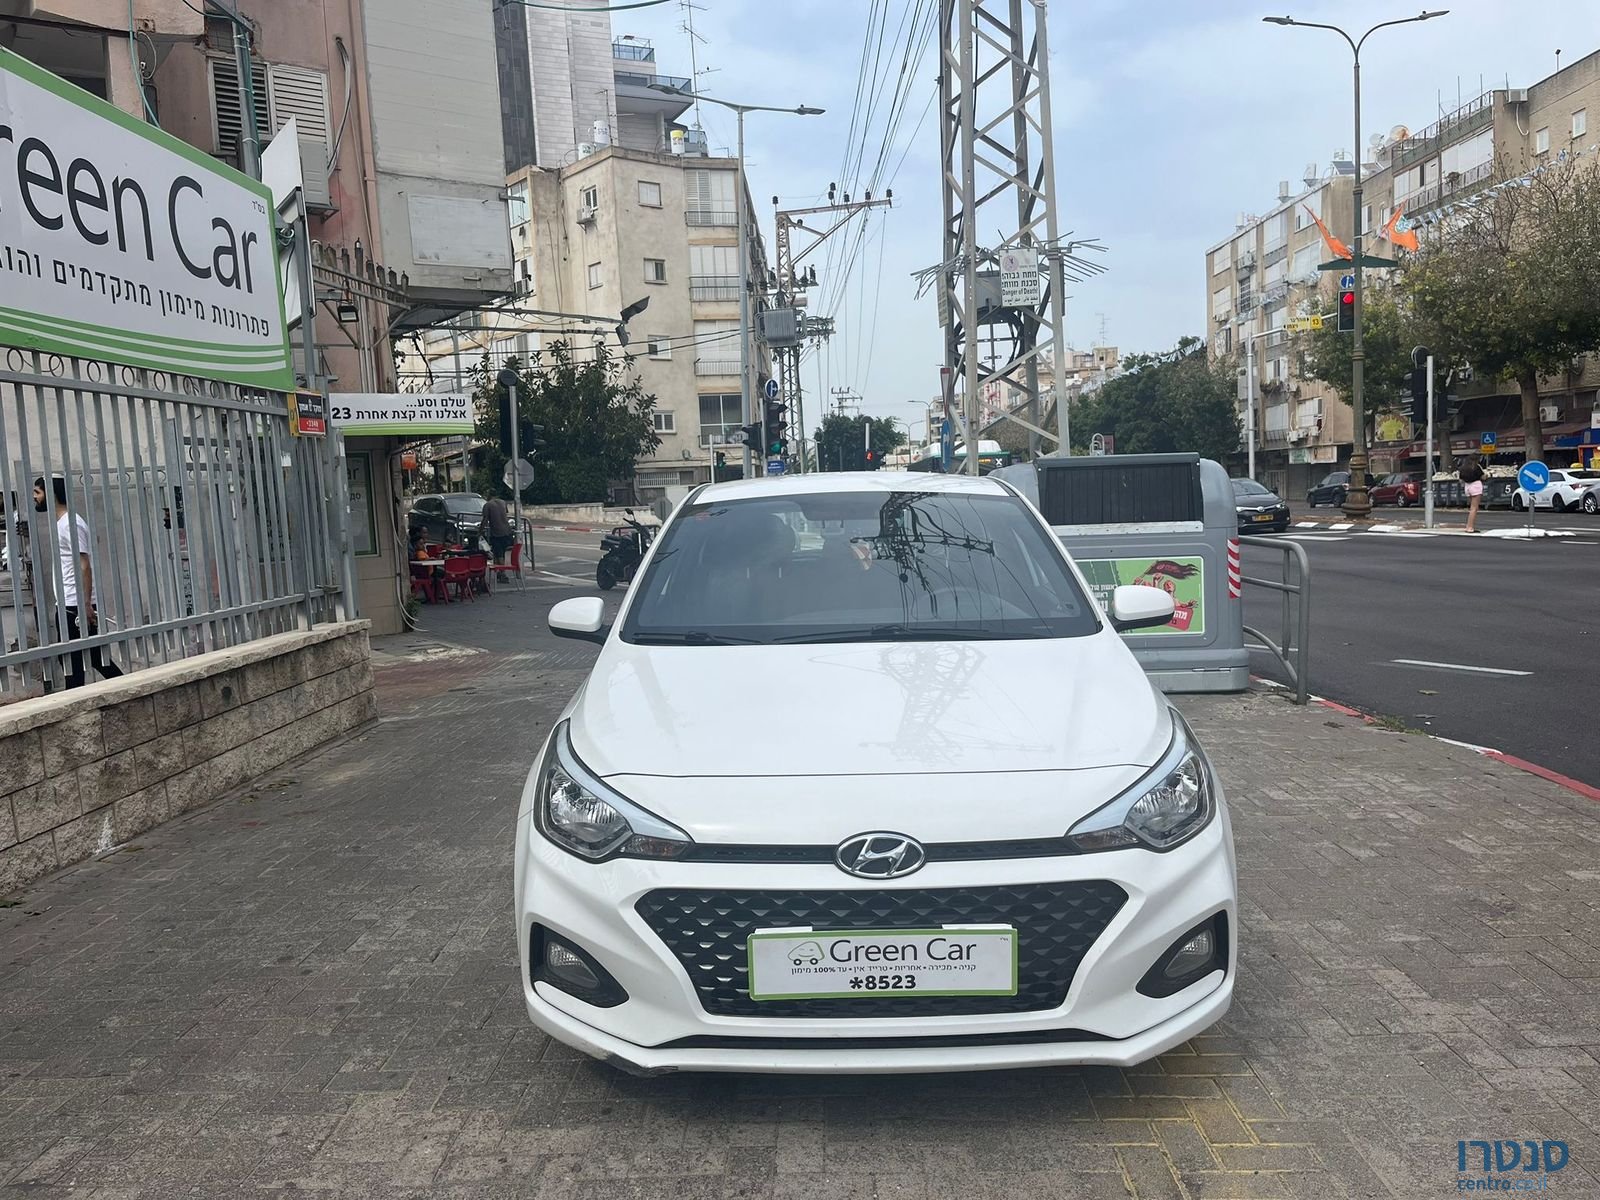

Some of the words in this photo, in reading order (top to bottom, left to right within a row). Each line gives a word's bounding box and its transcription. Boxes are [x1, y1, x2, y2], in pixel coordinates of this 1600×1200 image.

[0, 124, 155, 262] een
[168, 175, 258, 294] Car
[0, 246, 42, 278] והו
[53, 258, 152, 307] מתקדמים
[159, 289, 206, 321] מימון
[211, 304, 270, 337] פתרונות
[406, 398, 437, 407] וסע...
[440, 397, 466, 407] שלם
[331, 407, 352, 419] 23
[356, 410, 389, 419] אחרת
[392, 410, 416, 421] קצת
[420, 410, 432, 419] זה
[436, 408, 467, 419] אצלנו
[1505, 484, 1512, 494] 5
[829, 939, 918, 963] Green
[926, 937, 977, 961] Car
[791, 967, 812, 975] מימון
[958, 964, 976, 972] קניה
